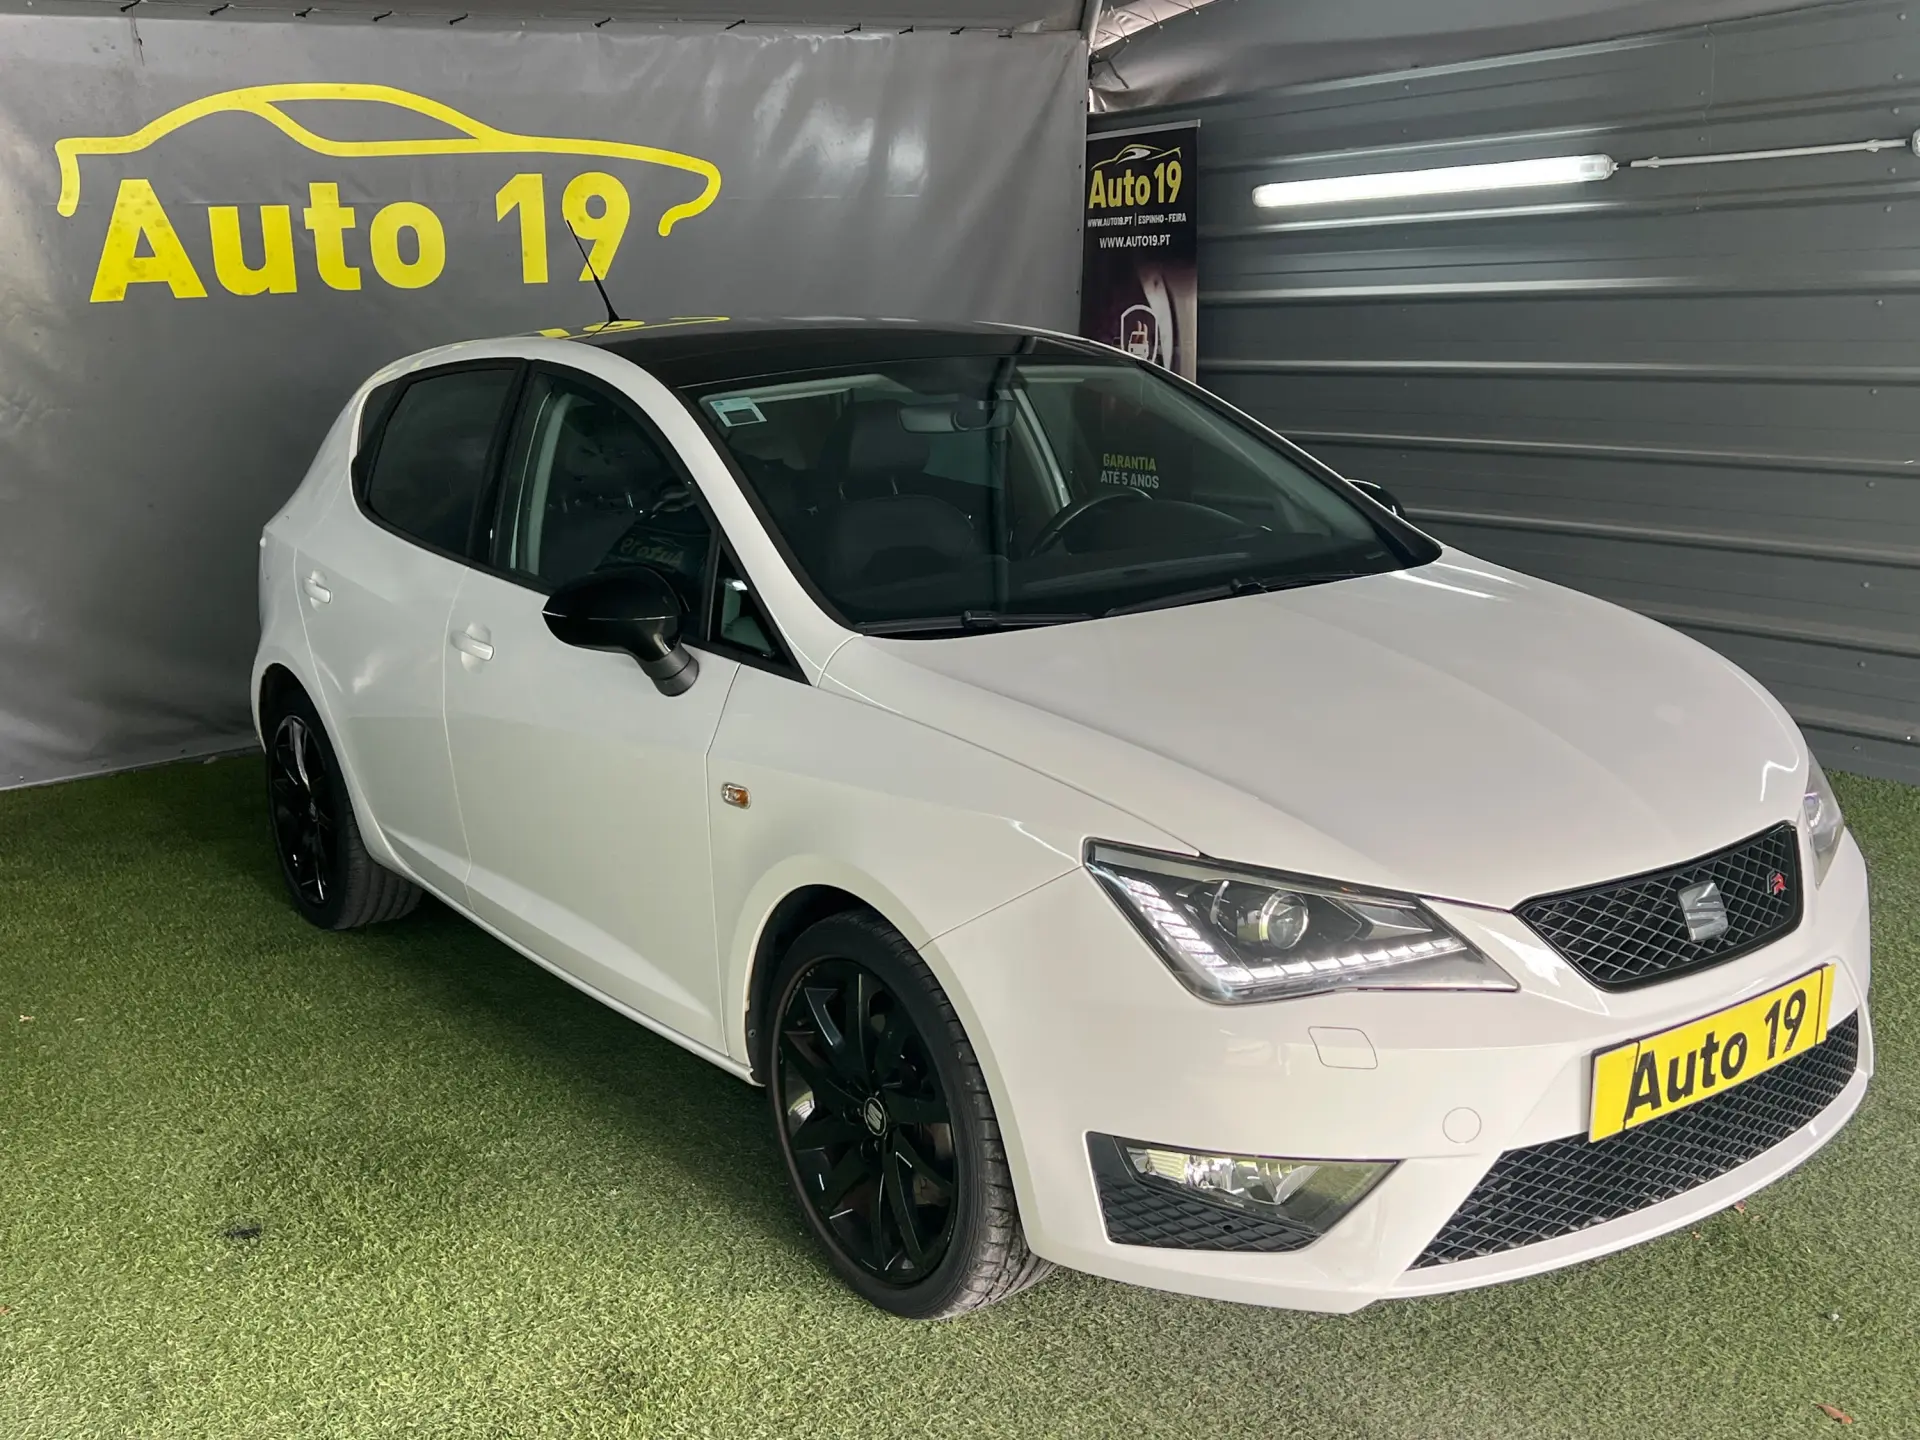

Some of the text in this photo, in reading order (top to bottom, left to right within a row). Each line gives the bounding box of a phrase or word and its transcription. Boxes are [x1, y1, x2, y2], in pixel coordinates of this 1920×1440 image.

[1088, 160, 1182, 209] Auto 19
[1138, 214, 1164, 224] ESPINHO
[1168, 213, 1187, 223] FEIRA
[89, 171, 631, 303] Auto 19
[1099, 234, 1171, 248] WWW.AUTO19.PT
[1103, 453, 1157, 471] GARANTIA
[1100, 469, 1160, 489] ATÉ 5 ANOS
[1626, 987, 1807, 1121] Auto 19
